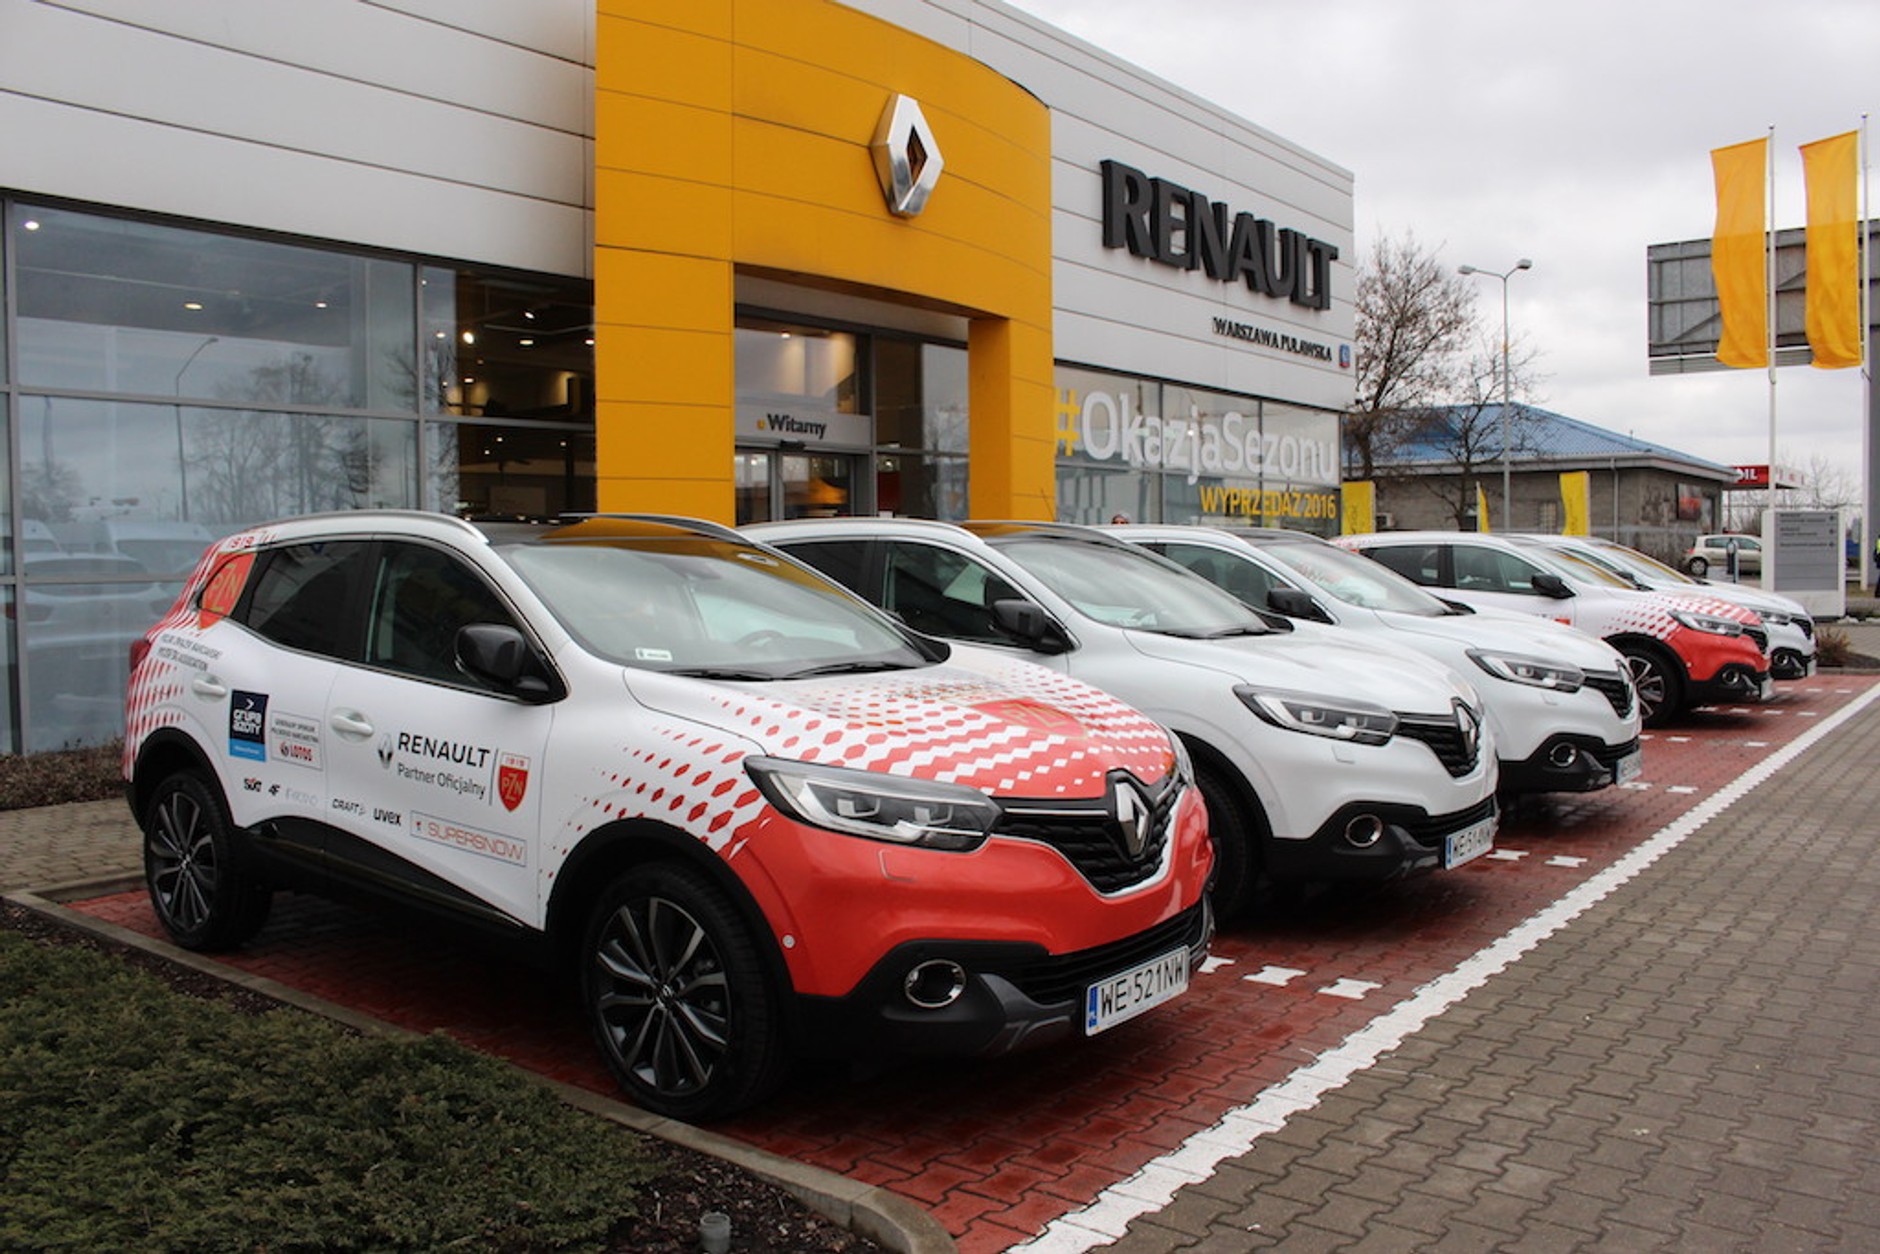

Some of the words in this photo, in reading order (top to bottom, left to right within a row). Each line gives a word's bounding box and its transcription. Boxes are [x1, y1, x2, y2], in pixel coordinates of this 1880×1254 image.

[1100, 159, 1339, 310] RENAULT
[767, 413, 827, 440] Witamy
[1055, 388, 1336, 485] #OkazjaSezonu
[1303, 494, 1337, 519] 2016
[398, 732, 491, 768] RENAULT
[397, 762, 436, 785] Partner
[436, 772, 486, 801] Oficjalny
[427, 821, 524, 861] SUPERSNOW
